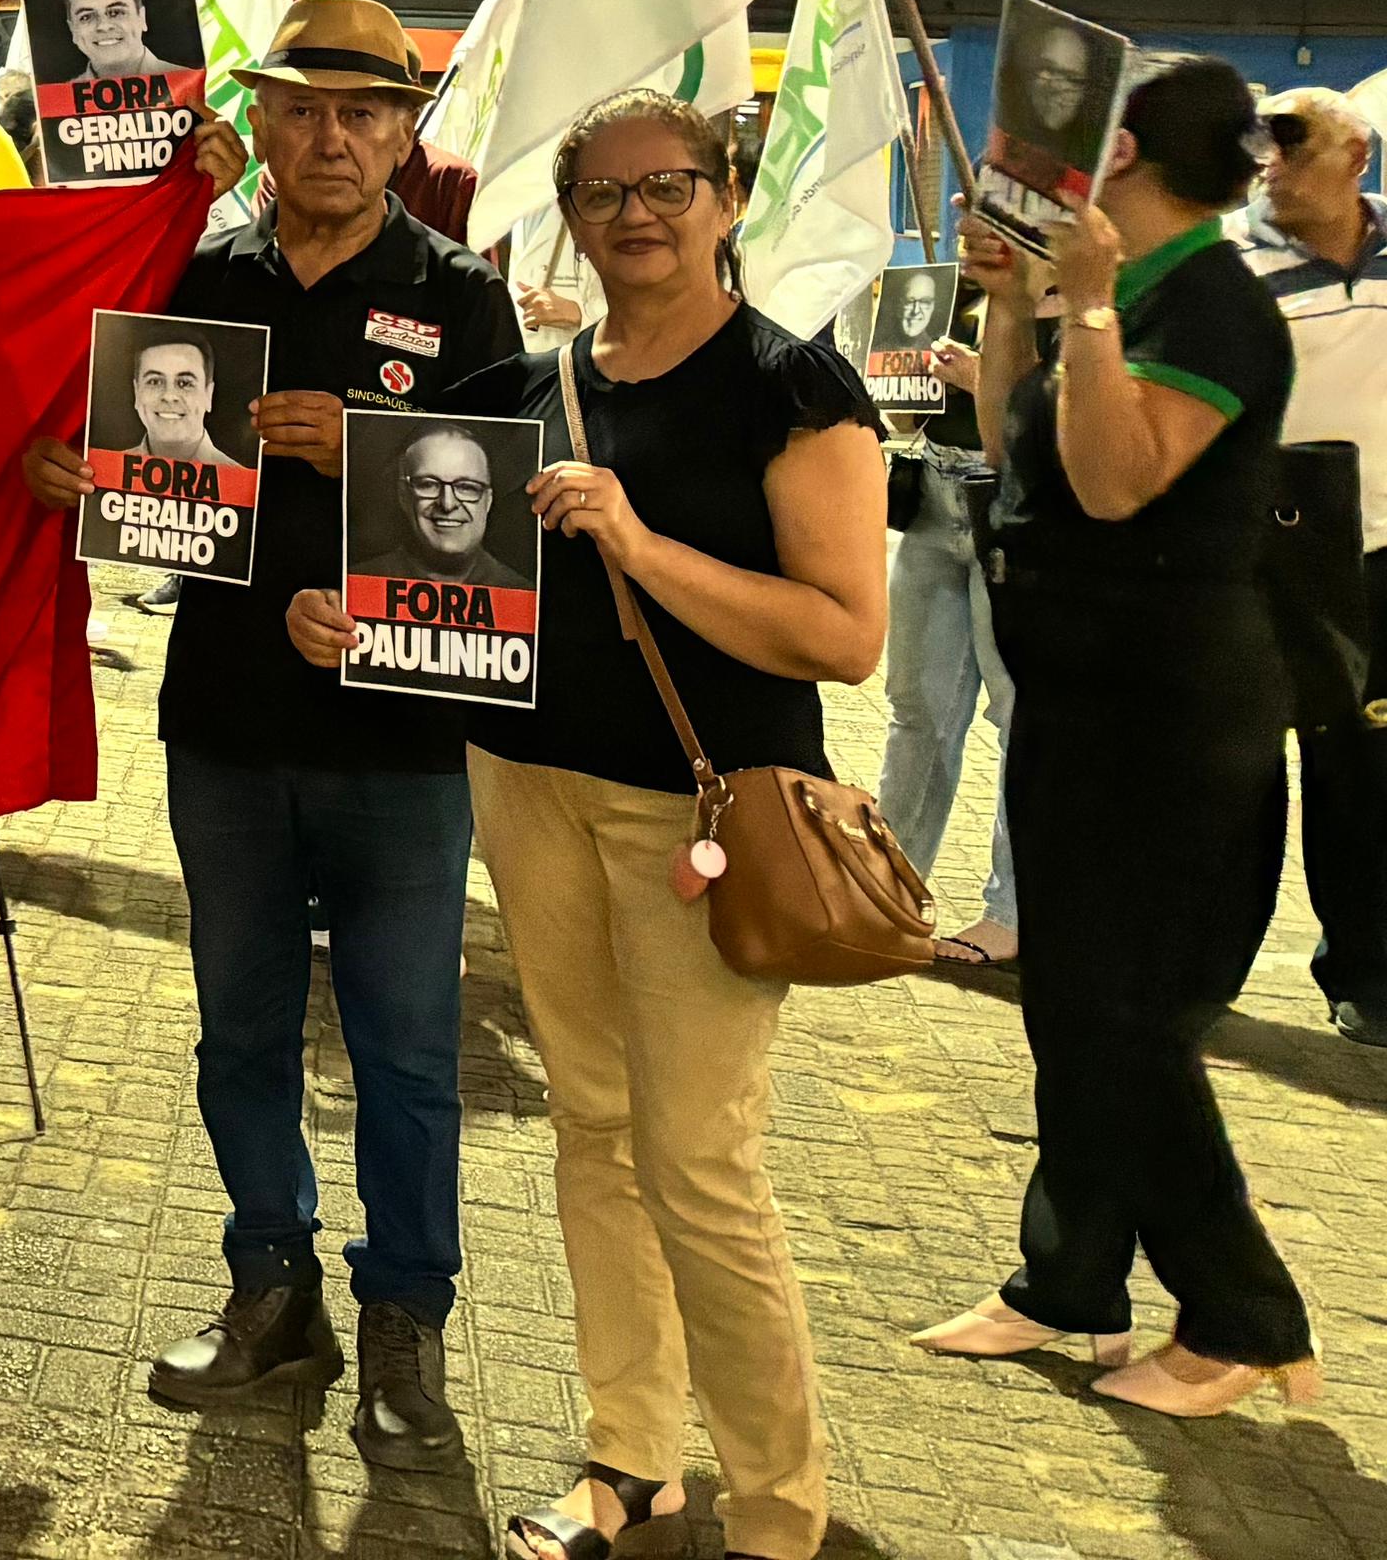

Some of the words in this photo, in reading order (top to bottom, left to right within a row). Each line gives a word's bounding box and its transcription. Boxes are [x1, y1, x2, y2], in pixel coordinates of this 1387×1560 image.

[72, 74, 174, 113] FORA
[58, 109, 193, 145] GERALDO
[82, 139, 173, 173] PINHO
[372, 312, 438, 335] CSP
[882, 352, 930, 375] FORA
[868, 375, 943, 401] PAULINHO
[122, 454, 220, 501] FORA
[100, 491, 239, 538] GERALDO
[119, 524, 215, 566] PINHO
[386, 579, 495, 628] FORA
[349, 621, 531, 683] PAULINHO
